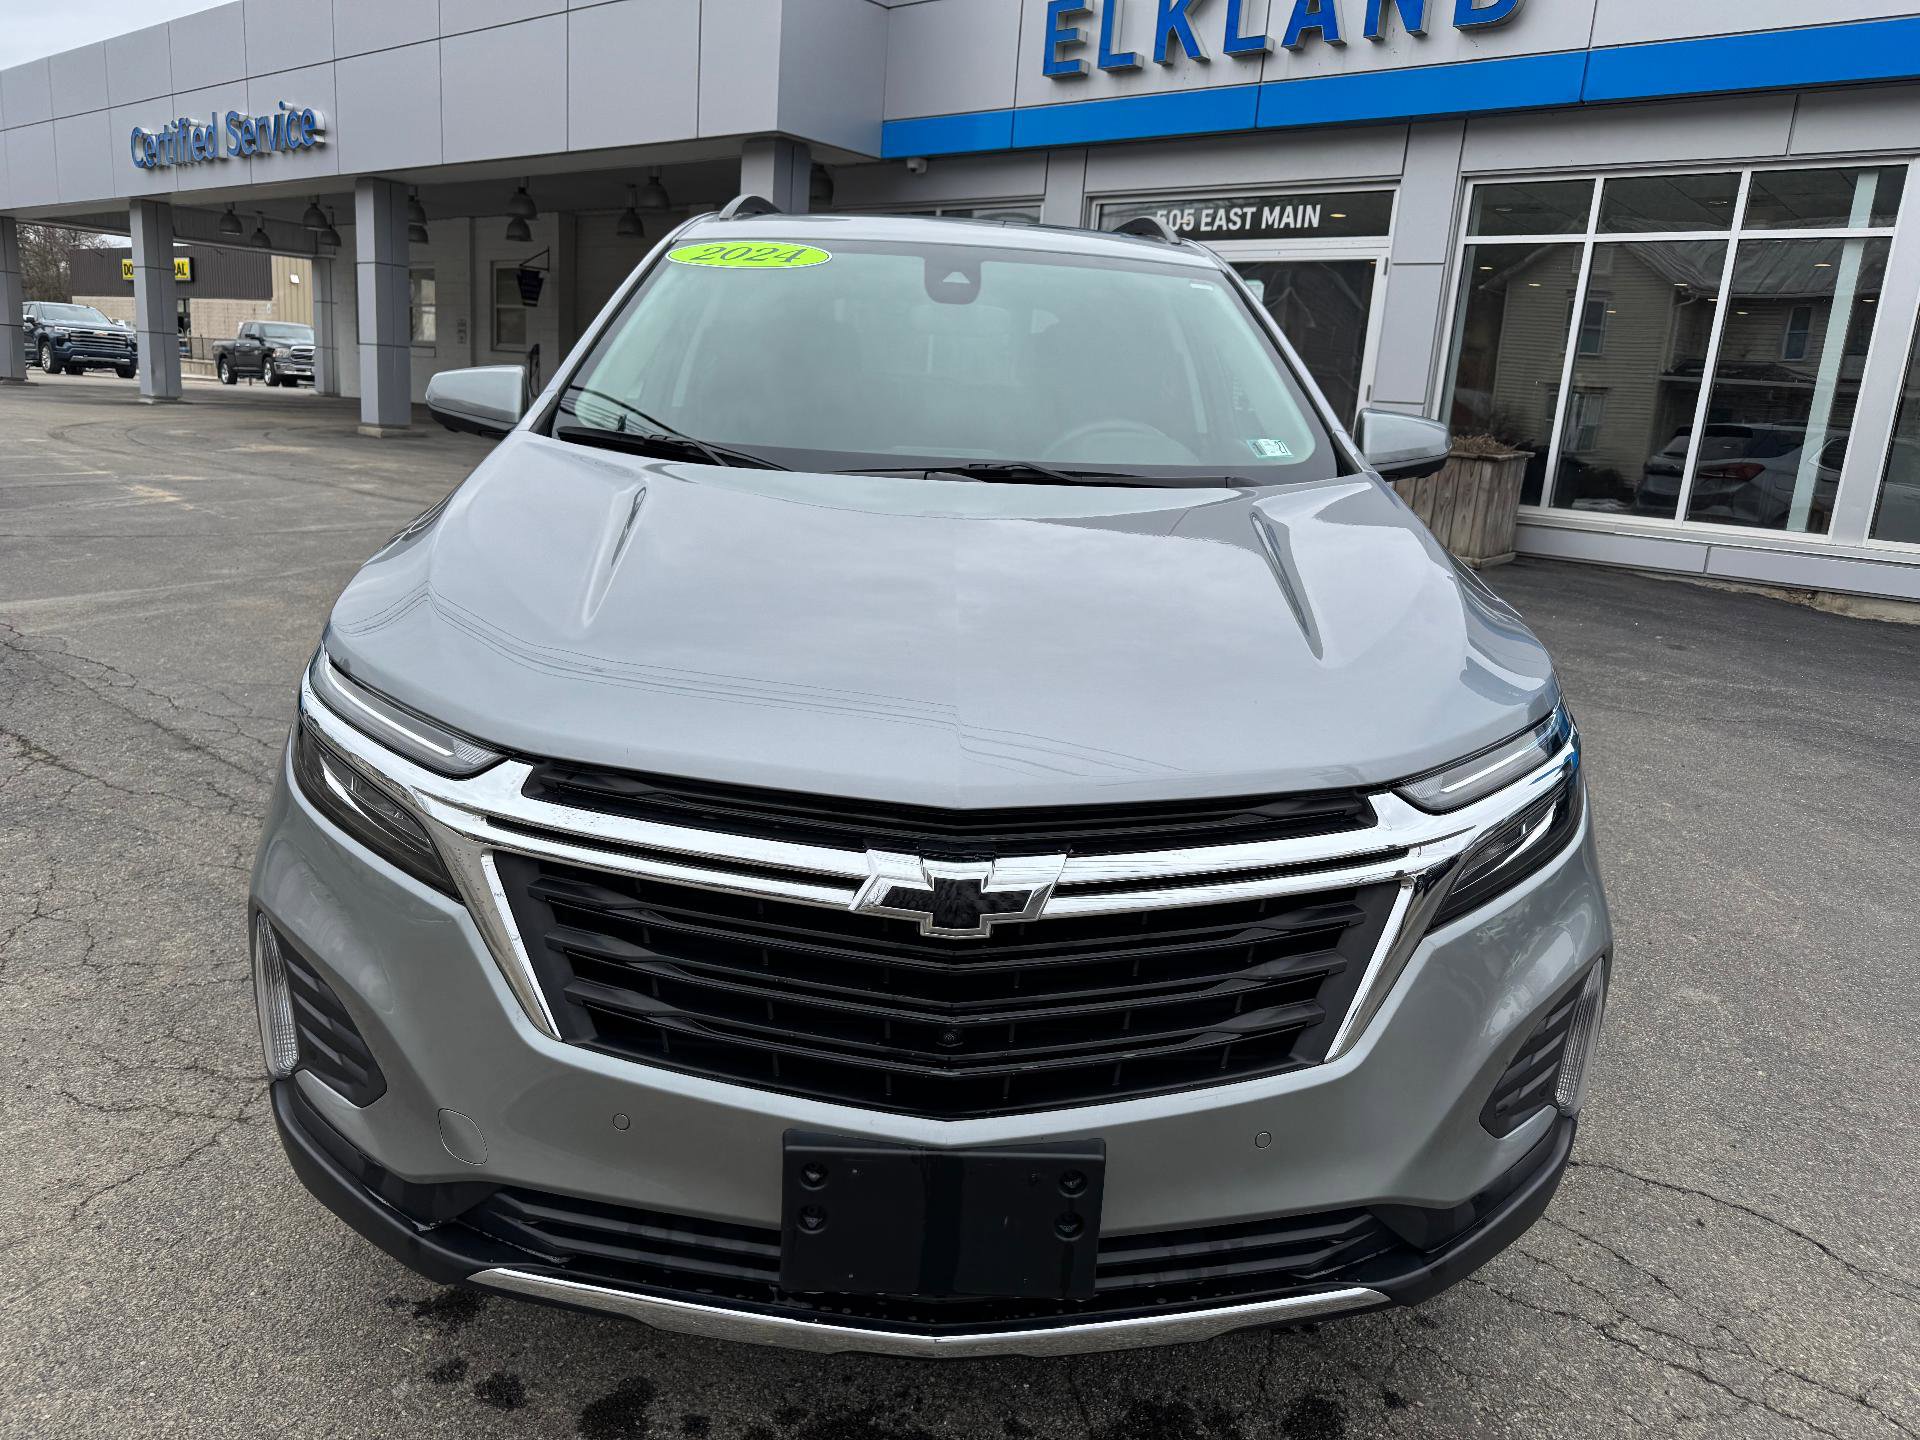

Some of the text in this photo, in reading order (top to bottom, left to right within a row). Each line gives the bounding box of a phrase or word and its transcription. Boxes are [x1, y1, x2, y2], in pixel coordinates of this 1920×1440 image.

[131, 100, 321, 169] Certified Service
[1156, 204, 1321, 231] 505 EAST MAIN
[689, 246, 808, 263] 2024
